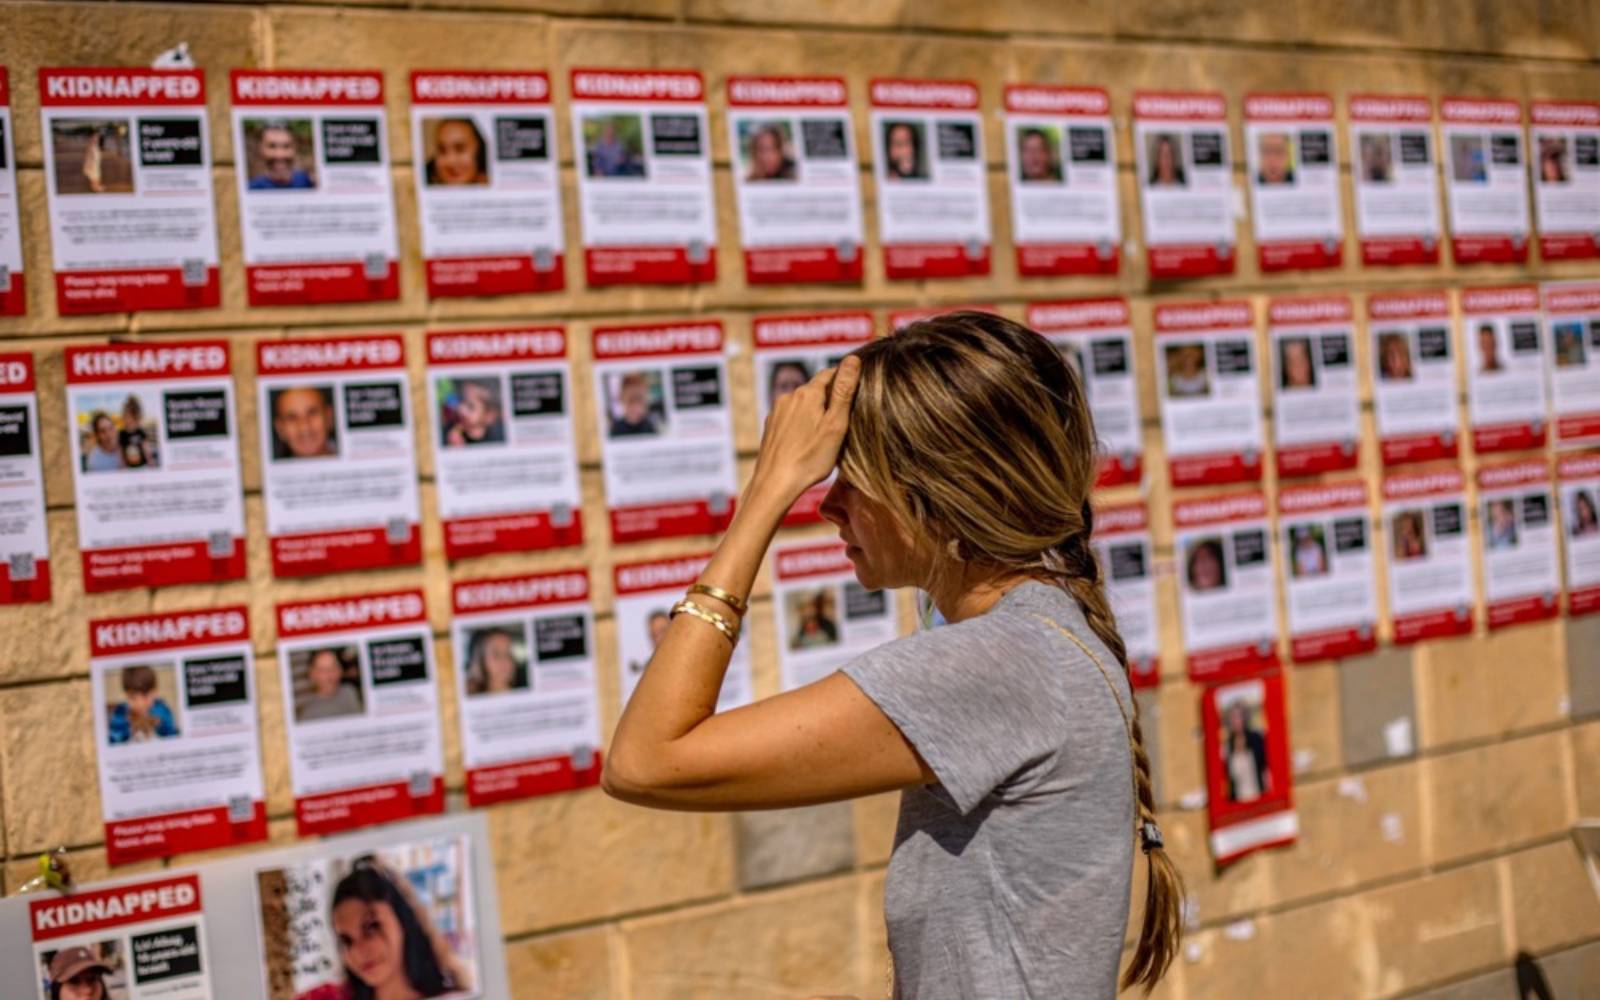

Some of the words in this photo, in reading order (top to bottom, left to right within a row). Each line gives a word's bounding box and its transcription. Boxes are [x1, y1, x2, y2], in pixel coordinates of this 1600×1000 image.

[47, 75, 200, 99] KIDNAPPED
[237, 76, 381, 99] KIDNAPPED
[416, 76, 547, 98] KIDNAPPED
[574, 74, 702, 98] KIDNAPPED
[262, 340, 401, 367] KIDNAPPED
[431, 331, 565, 358] KIDNAPPED
[597, 327, 722, 353] KIDNAPPED
[73, 346, 226, 375] KIDNAPPED
[456, 575, 587, 607] KIDNAPPED
[281, 594, 423, 630] KIDNAPPED
[96, 612, 245, 648] KIDNAPPED
[36, 883, 195, 930] KIDNAPPED
